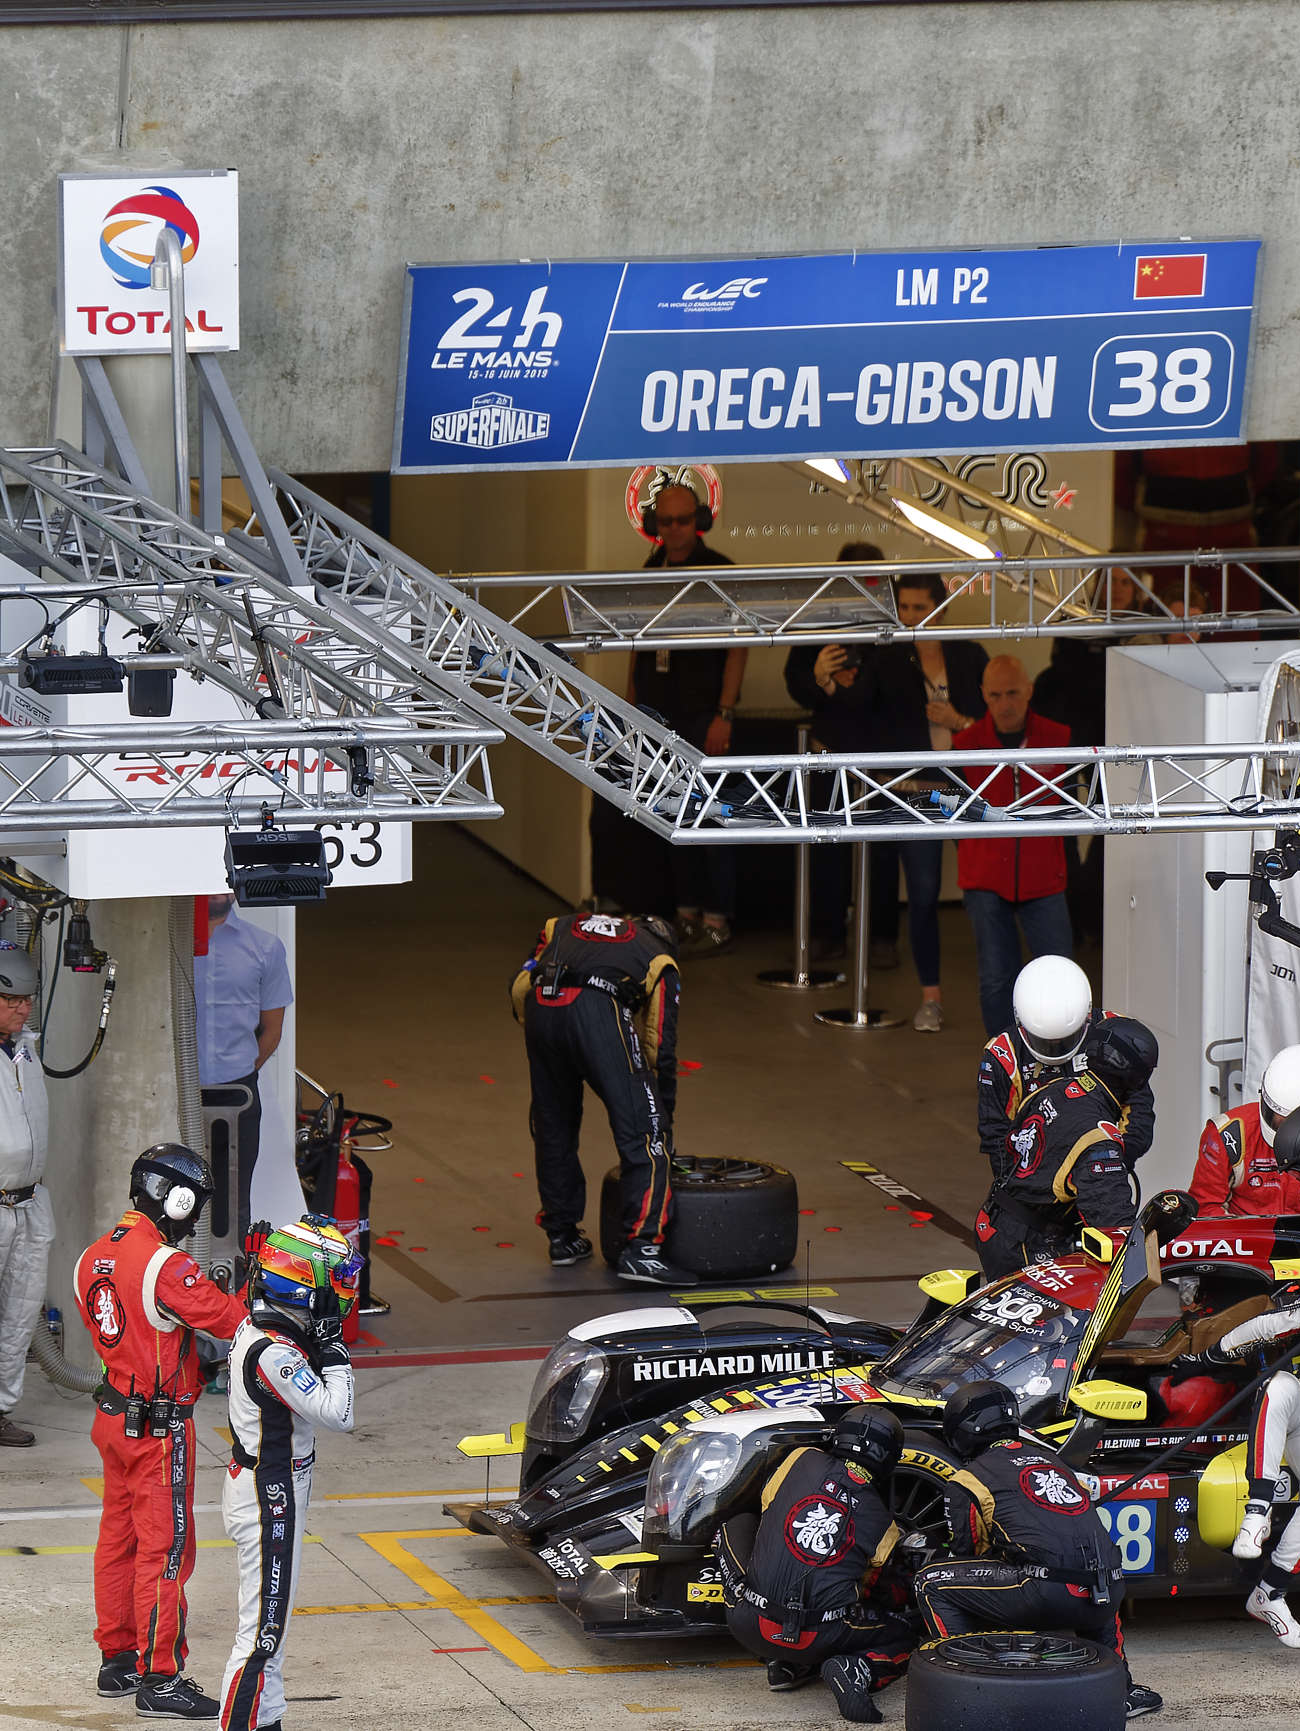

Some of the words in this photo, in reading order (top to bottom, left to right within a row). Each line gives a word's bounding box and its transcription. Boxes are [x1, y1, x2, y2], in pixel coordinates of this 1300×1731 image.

[682, 277, 768, 300] WEC
[896, 269, 938, 306] LM
[952, 267, 989, 304] P2
[437, 285, 563, 349] 24h
[431, 352, 467, 369] LE
[470, 351, 553, 368] MANS
[468, 370, 495, 379] 15-16
[498, 369, 521, 379] JUIN
[524, 369, 548, 379] 2019
[641, 356, 1057, 433] ORECA-GIBSON
[1108, 347, 1212, 416] 38
[433, 407, 548, 447] SUPERFINALE
[15, 695, 50, 723] CORVETTE
[1041, 1258, 1075, 1285] OTAL
[1032, 1296, 1060, 1310] CHAN
[971, 1310, 1009, 1327] JOTA
[1008, 1321, 1046, 1337] Sport
[633, 1353, 755, 1382] RICHARD
[761, 1350, 835, 1373] MILLE
[557, 1538, 589, 1575] TOTAL
[270, 1555, 281, 1596] JOTA
